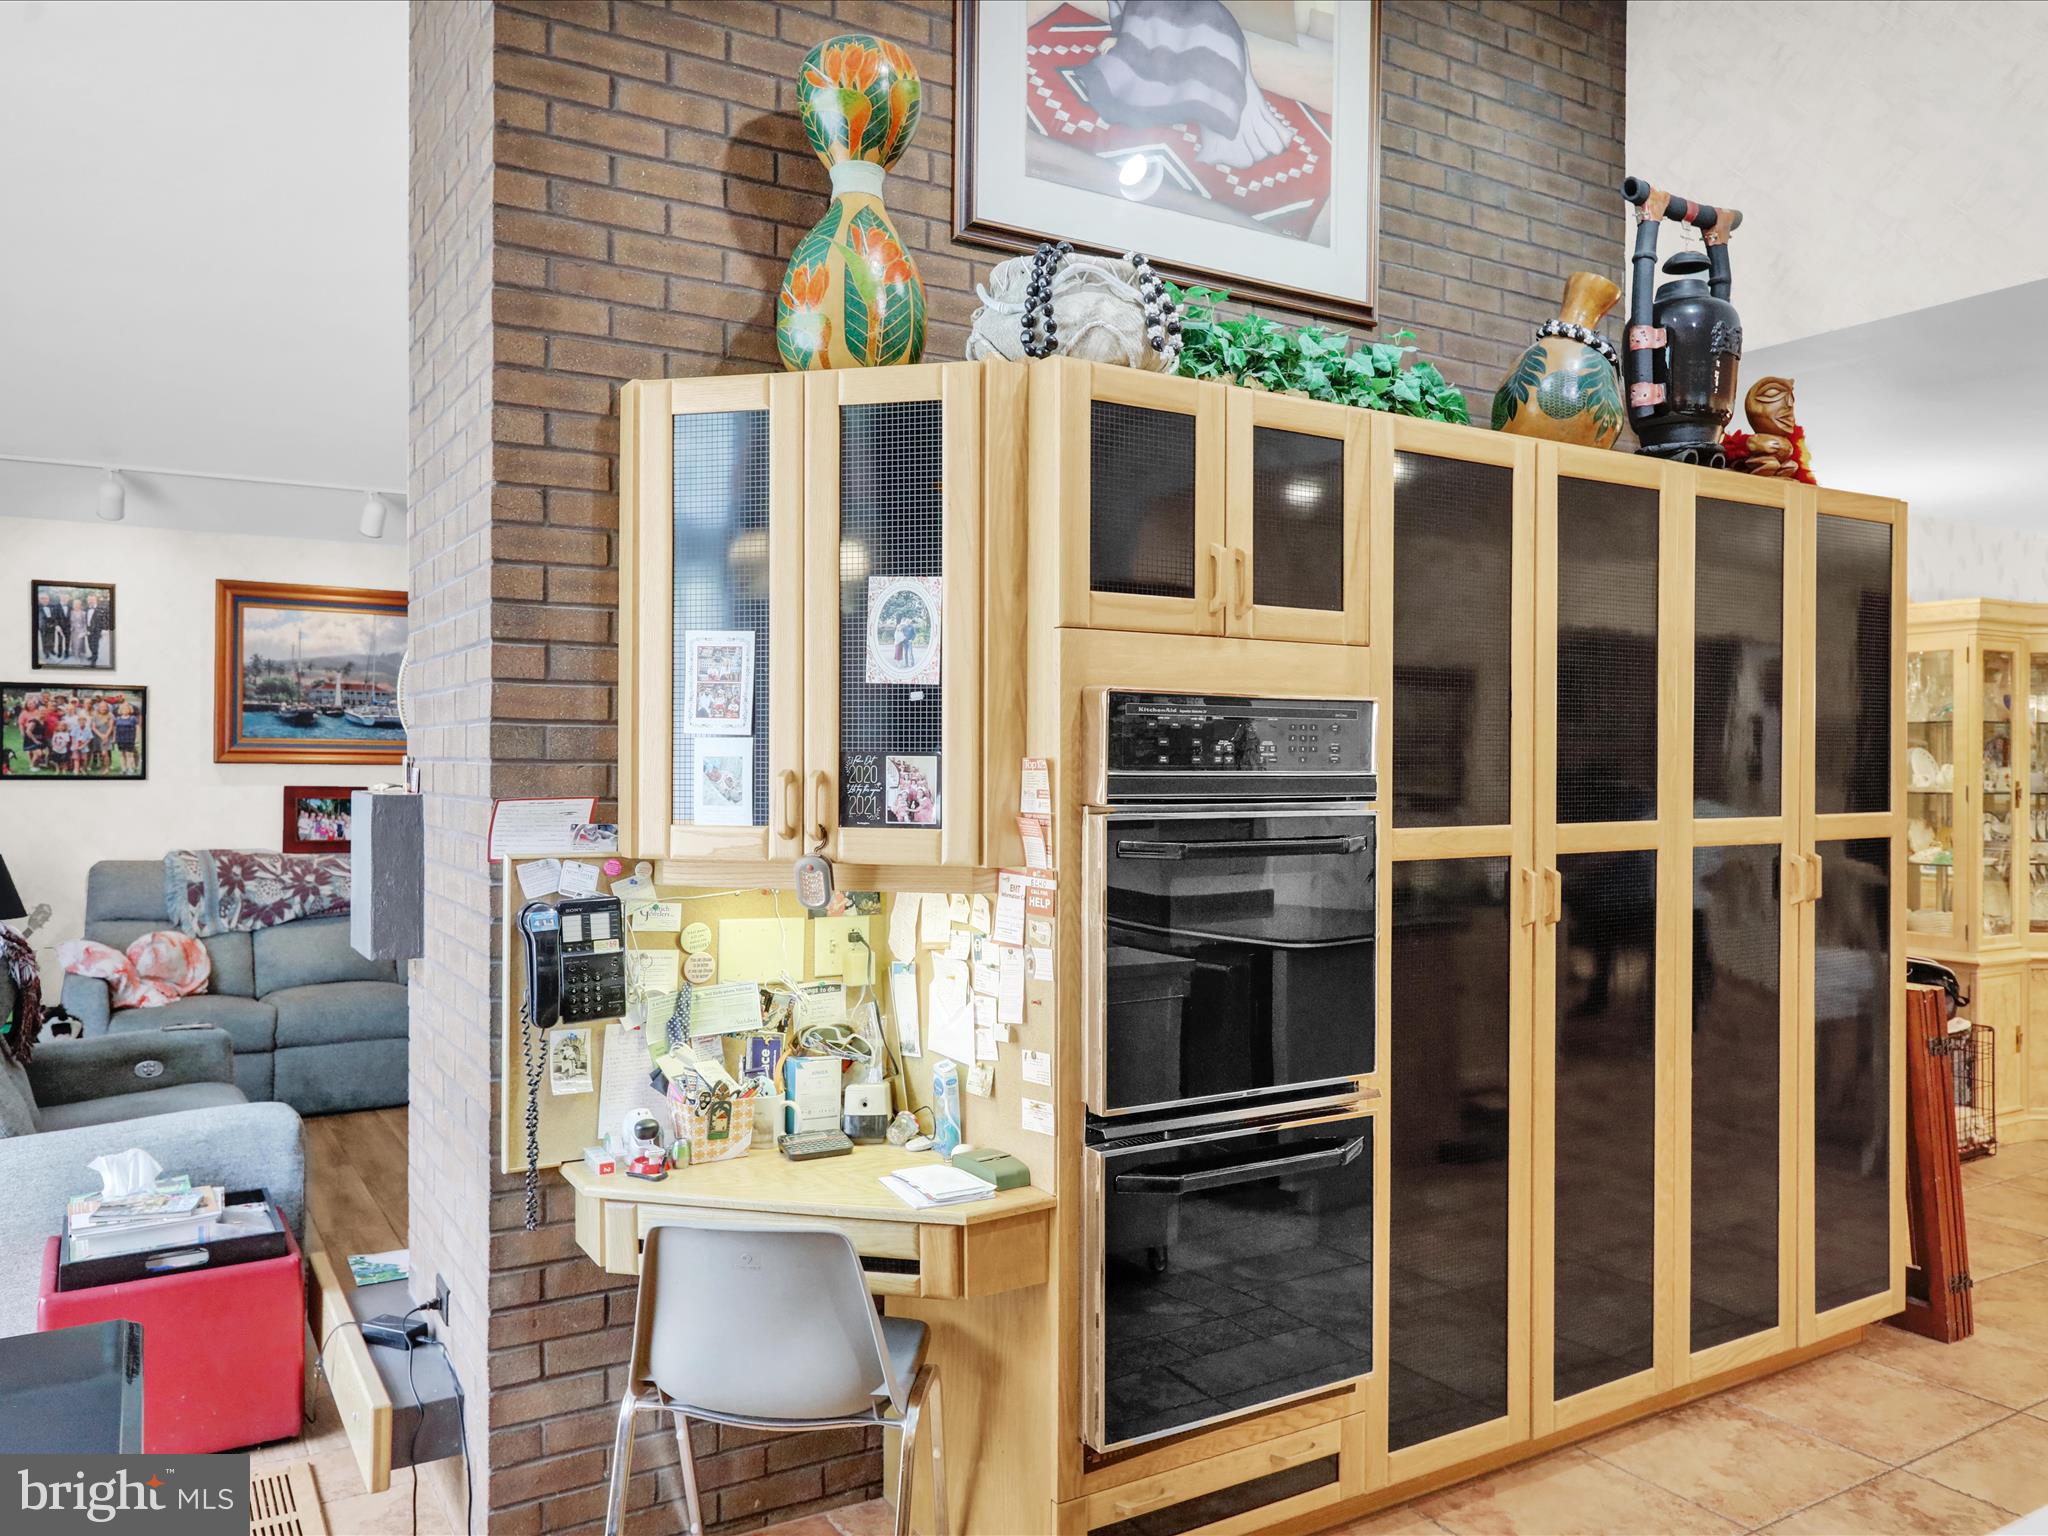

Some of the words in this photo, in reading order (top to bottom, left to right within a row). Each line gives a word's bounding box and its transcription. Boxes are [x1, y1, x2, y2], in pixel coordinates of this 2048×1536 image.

[1138, 706, 1177, 714] KitchenAid
[848, 765, 878, 784] 2020
[848, 796, 877, 815] 2021
[1029, 896, 1051, 909] HELP
